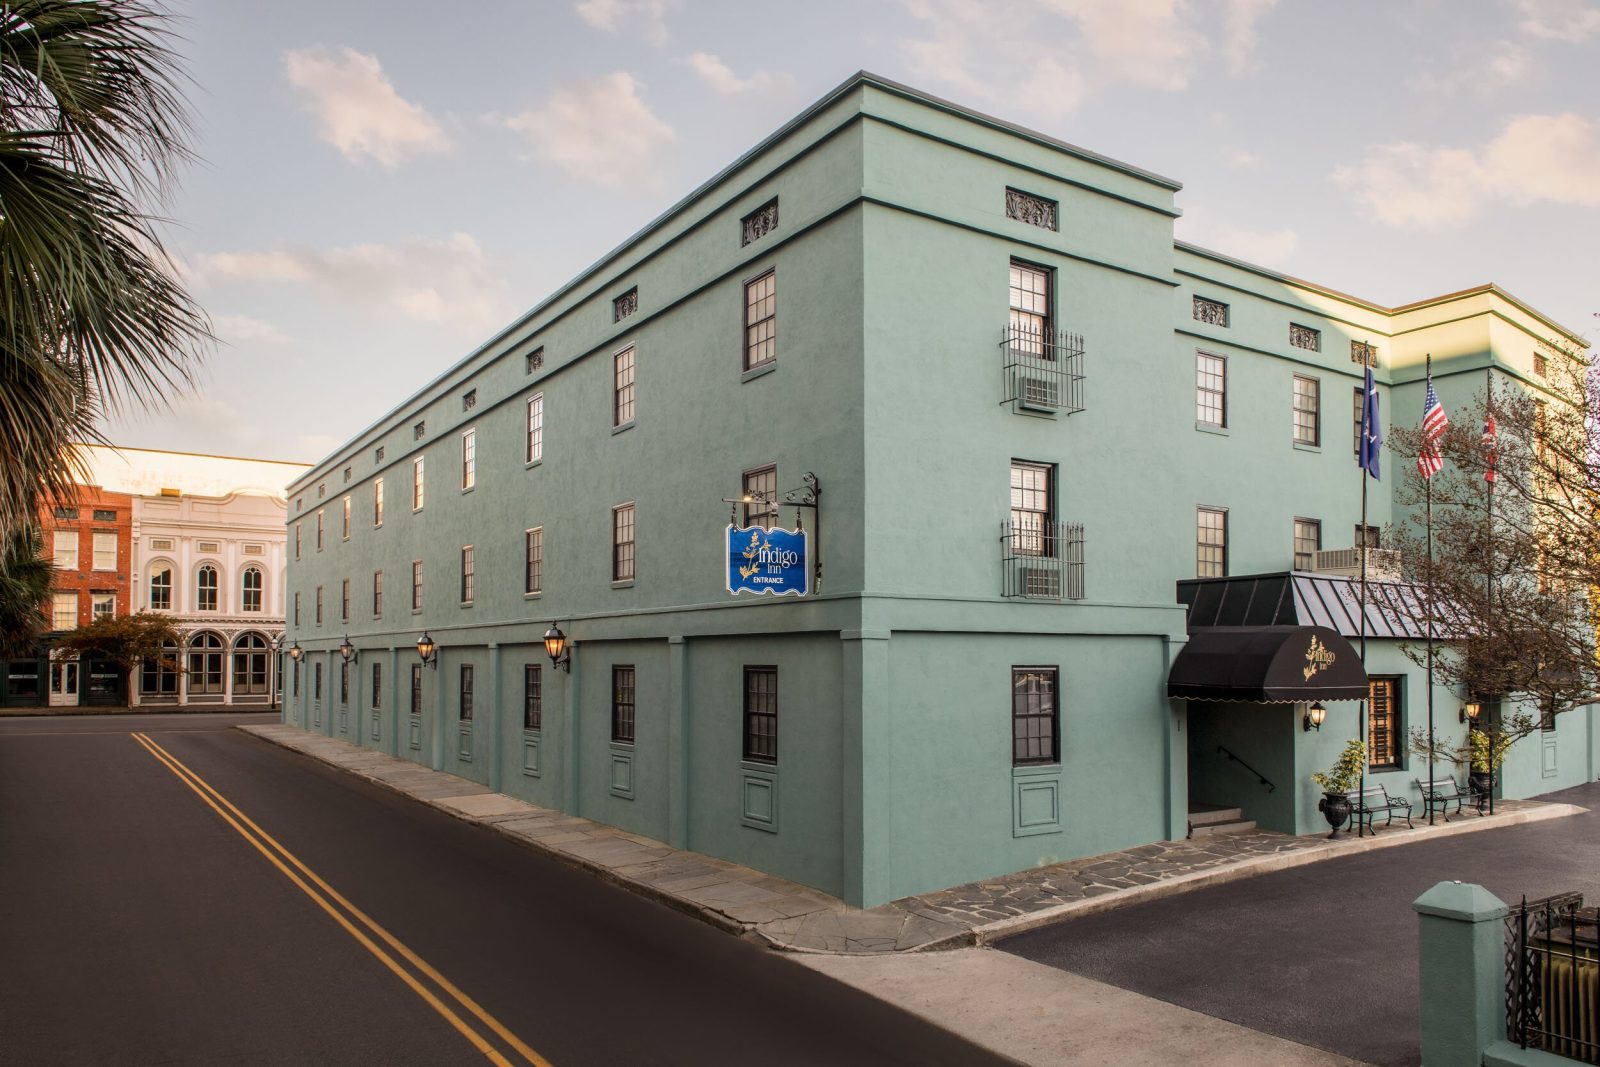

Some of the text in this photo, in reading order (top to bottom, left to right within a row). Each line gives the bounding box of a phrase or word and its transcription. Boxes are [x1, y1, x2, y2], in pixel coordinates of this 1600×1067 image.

[758, 547, 798, 569] Indigo
[767, 563, 782, 574] Inn
[753, 576, 784, 584] ENTRANCE
